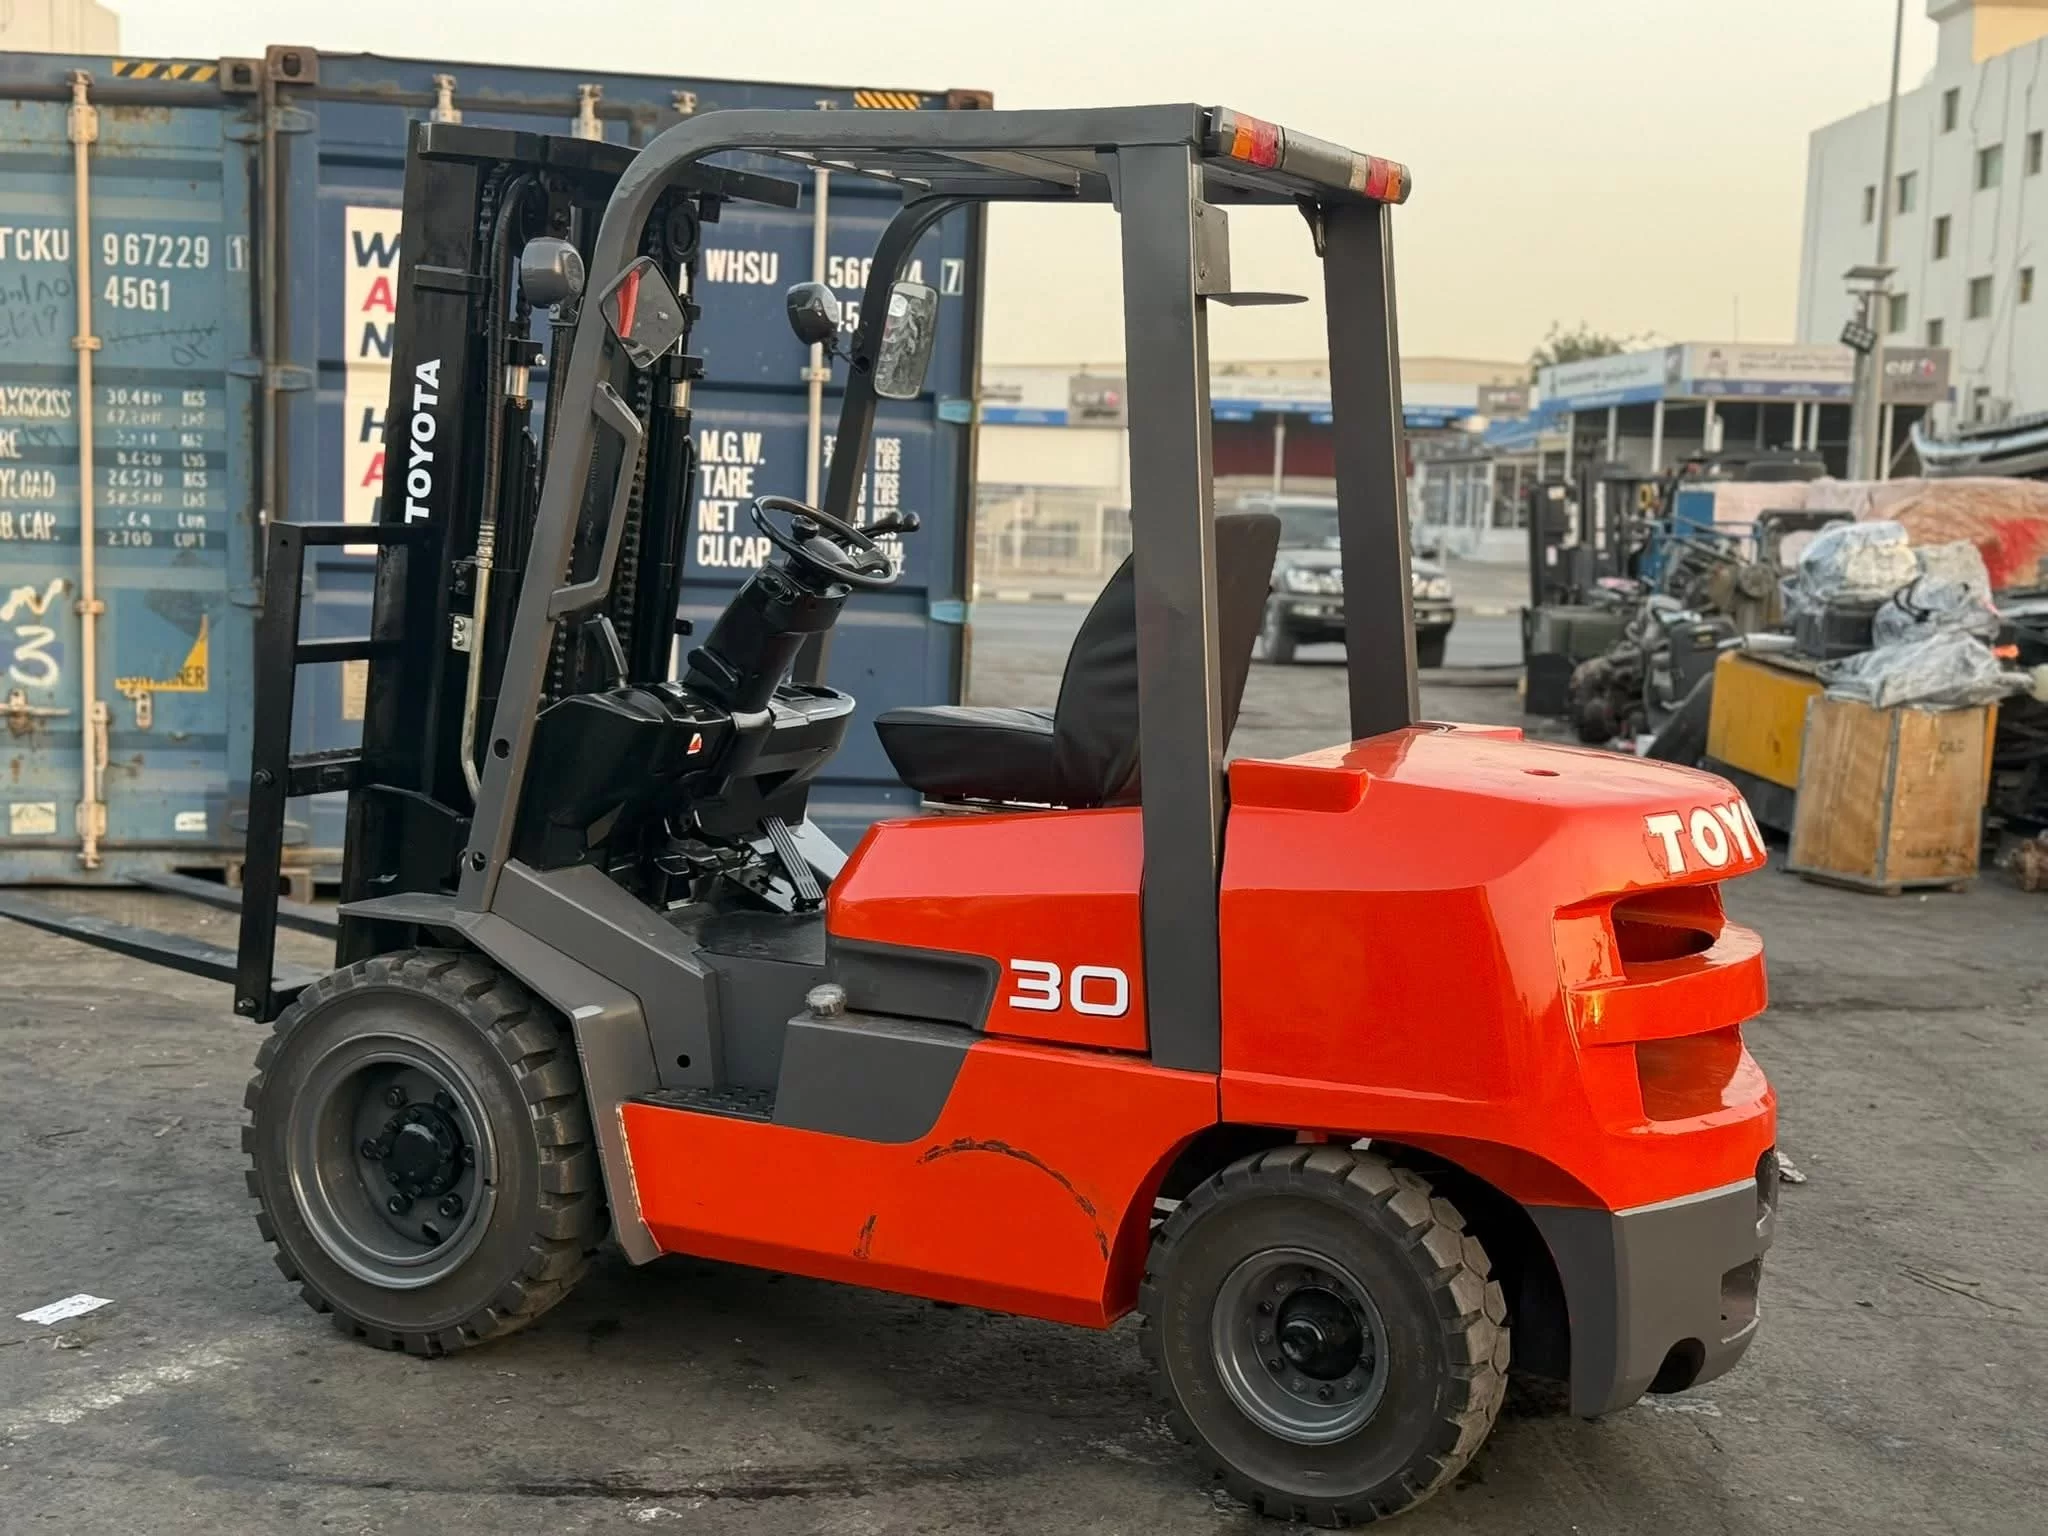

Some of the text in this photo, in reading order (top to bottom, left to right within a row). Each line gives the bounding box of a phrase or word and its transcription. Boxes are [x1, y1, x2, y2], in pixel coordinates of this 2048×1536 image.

[0, 227, 70, 261] TCKU
[103, 233, 209, 268] 967229
[706, 249, 779, 284] WHSU
[103, 275, 170, 311] 45G1
[404, 358, 441, 524] TOYOTA
[700, 429, 766, 465] M.G.W.
[699, 464, 754, 499] TARE
[698, 500, 739, 532] NET
[1009, 958, 1130, 1018] 30
